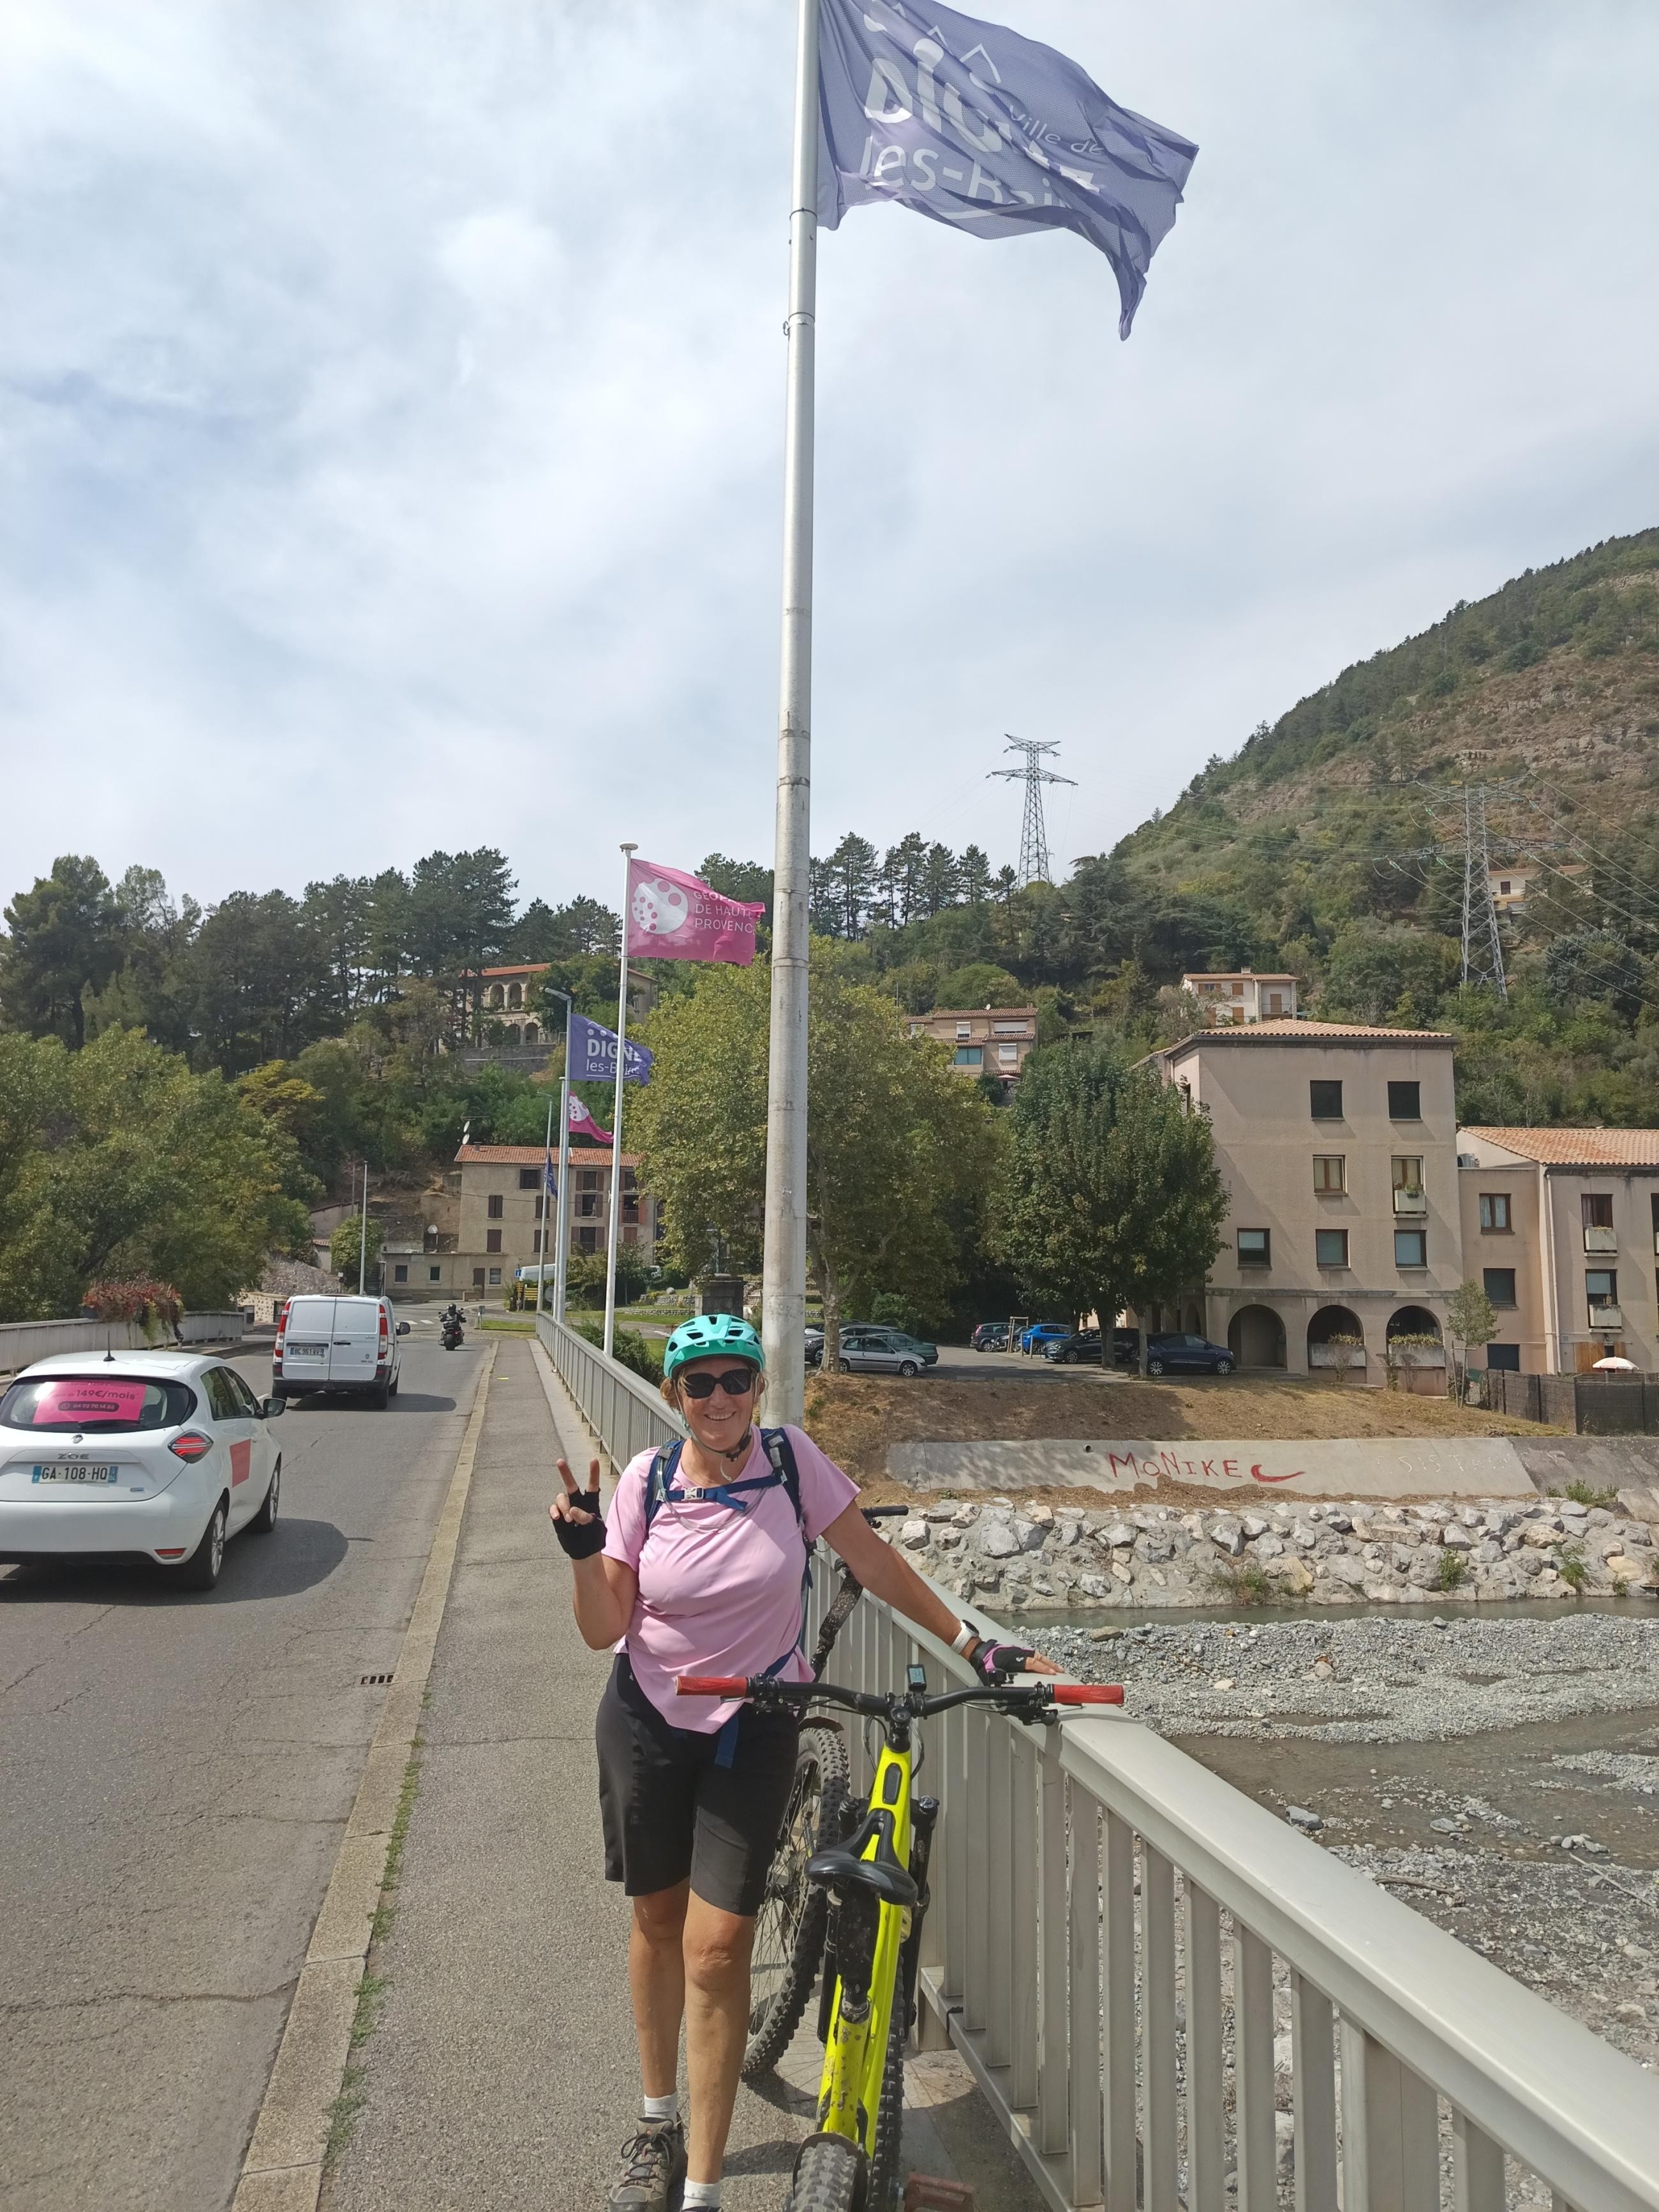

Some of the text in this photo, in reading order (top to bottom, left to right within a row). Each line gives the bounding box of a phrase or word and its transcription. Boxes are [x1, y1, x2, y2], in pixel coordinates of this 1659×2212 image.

[1009, 105, 1061, 144] ville
[696, 904, 712, 915] DE
[695, 918, 753, 934] PROVENC
